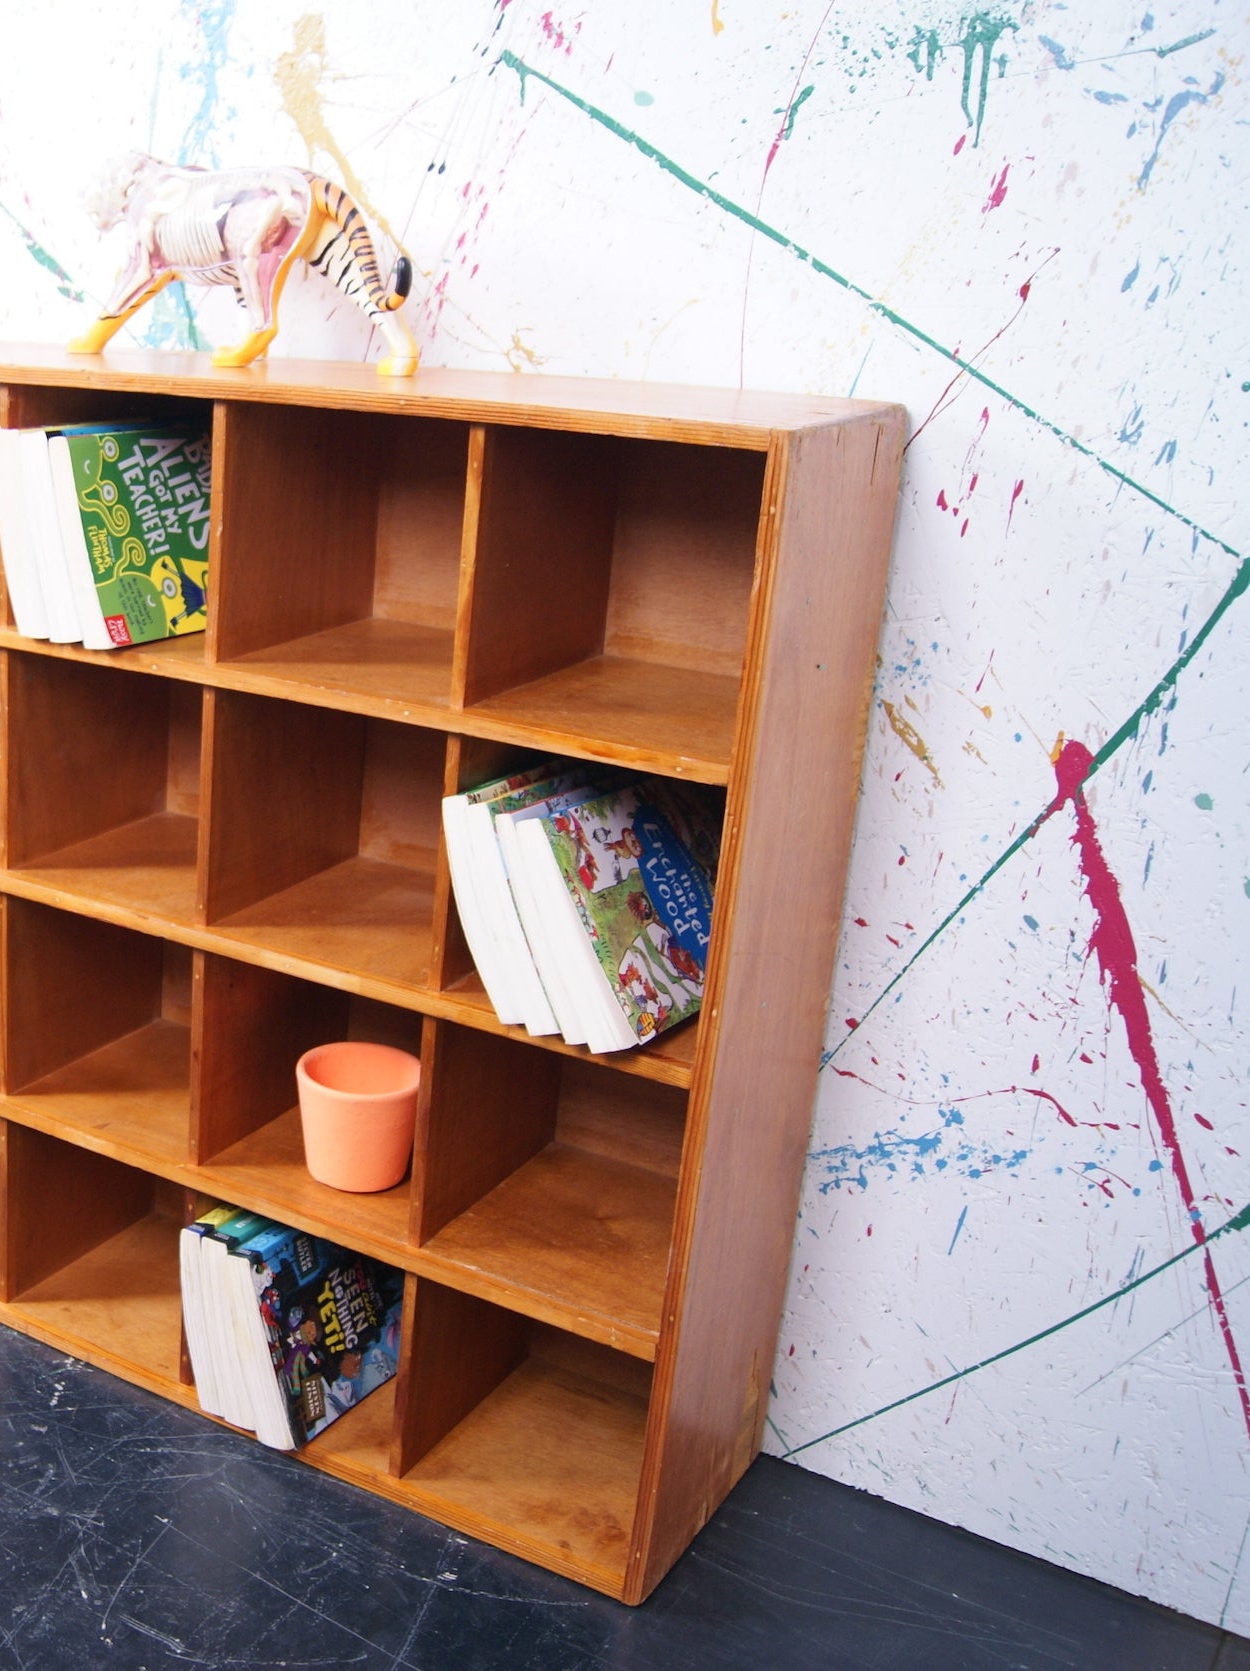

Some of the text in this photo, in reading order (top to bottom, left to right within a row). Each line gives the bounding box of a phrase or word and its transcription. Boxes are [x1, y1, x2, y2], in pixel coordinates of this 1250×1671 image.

[118, 445, 170, 556] TEACHER!
[140, 438, 211, 550] ALIENS
[149, 470, 182, 534] GOT MY
[98, 527, 114, 568] THOMAS
[643, 822, 710, 947] Enchanted
[646, 857, 690, 937] Wood
[327, 1268, 358, 1349] NOTHING
[343, 1268, 368, 1333] SEEN
